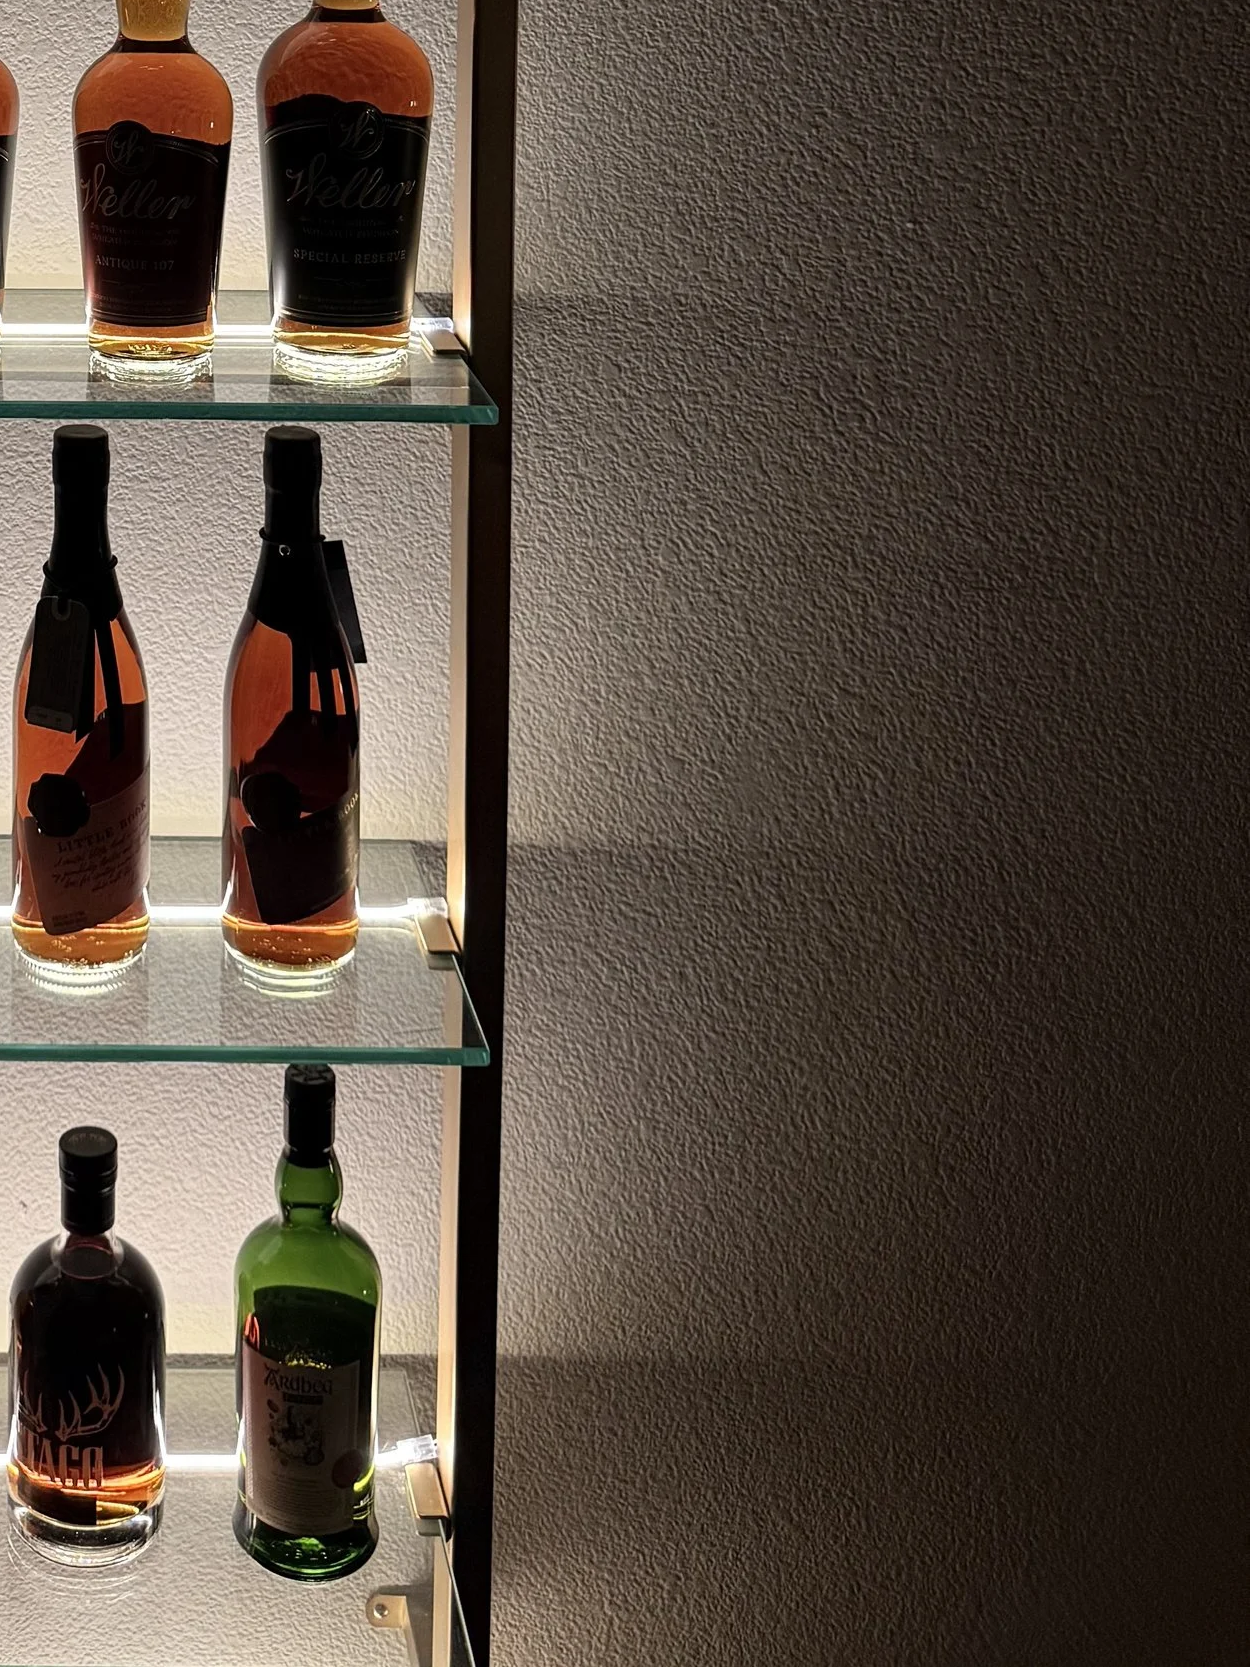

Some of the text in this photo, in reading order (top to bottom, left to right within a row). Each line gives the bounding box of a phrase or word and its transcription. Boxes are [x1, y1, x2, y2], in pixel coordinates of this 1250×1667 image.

[80, 162, 197, 220] Weller
[285, 151, 417, 210] Weller
[95, 254, 175, 271] ANTIQUE 107
[293, 247, 407, 265] SPECIAL RESERVE
[56, 826, 114, 853] LITTLE
